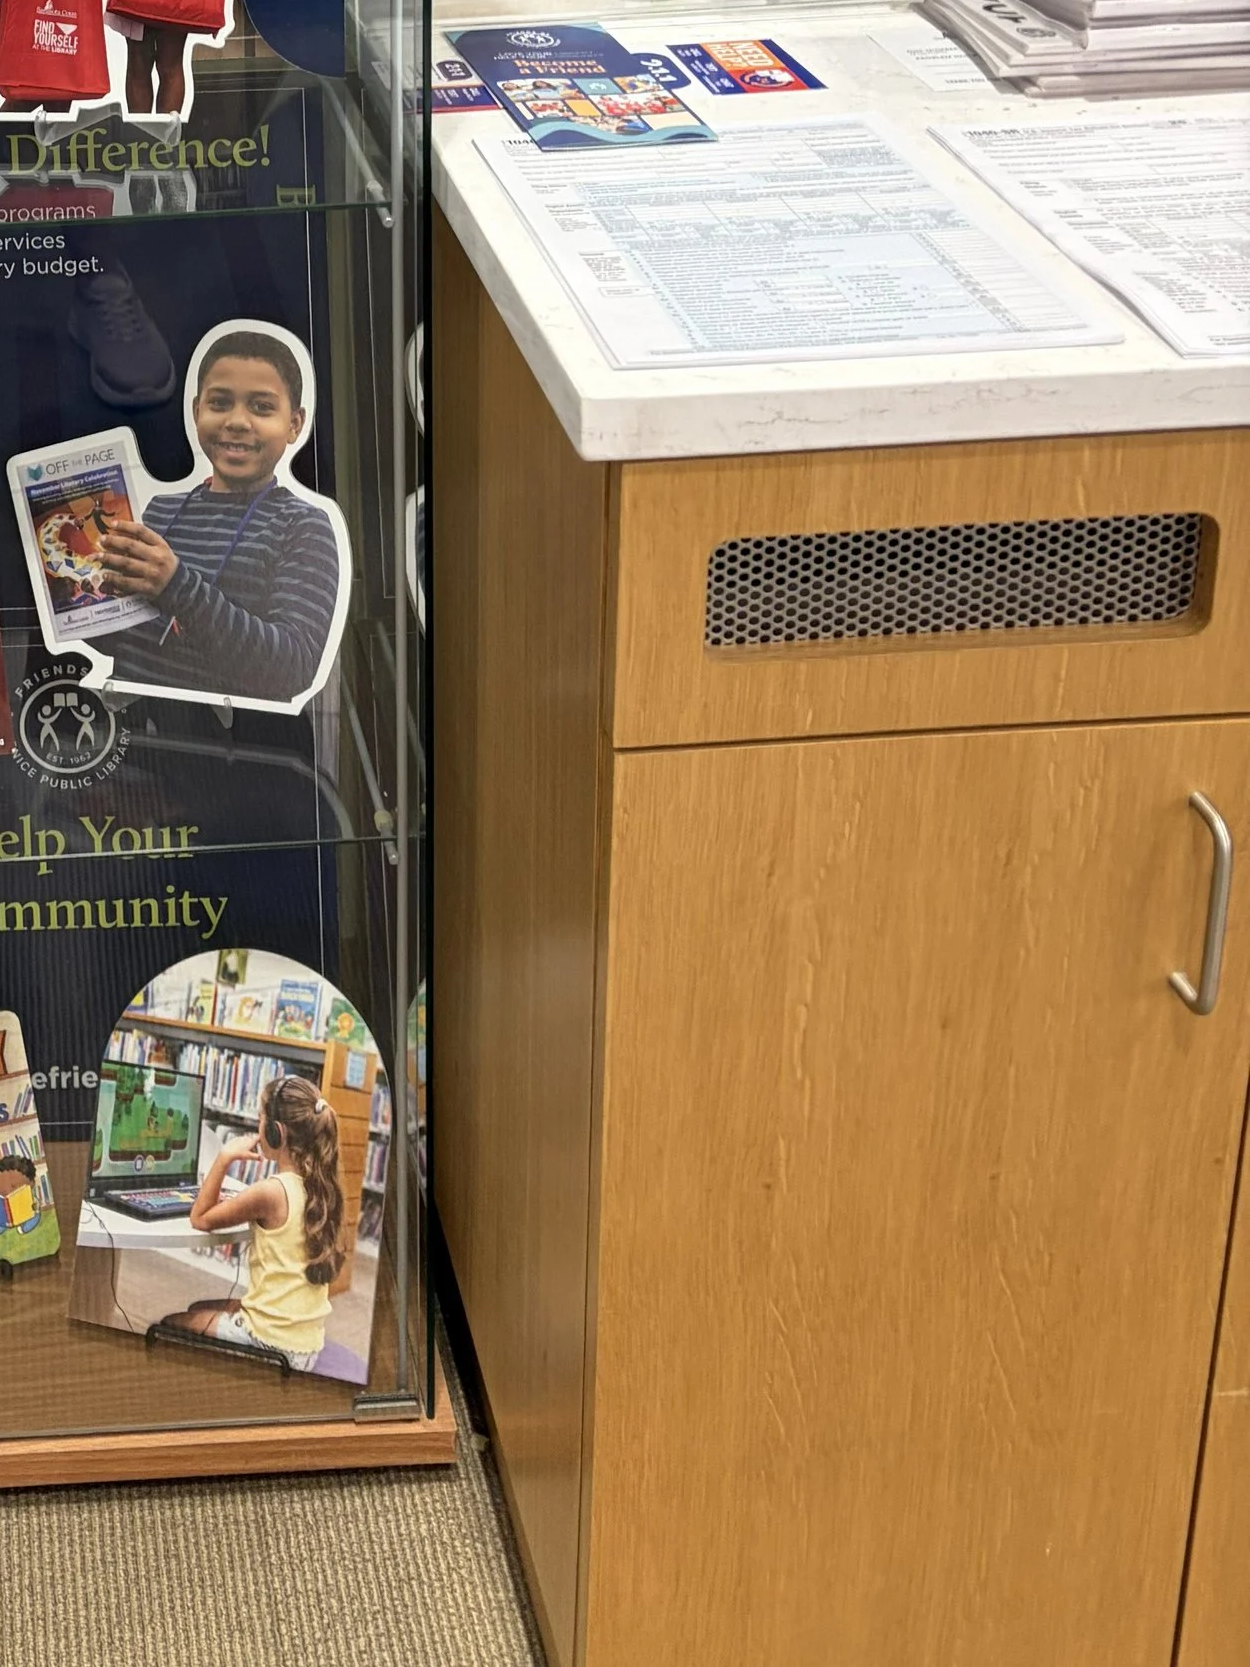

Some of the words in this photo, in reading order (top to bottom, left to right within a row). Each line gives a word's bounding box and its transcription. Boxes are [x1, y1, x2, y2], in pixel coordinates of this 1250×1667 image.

[34, 20, 55, 34] FIND
[34, 33, 78, 49] YOURSELF
[51, 46, 78, 56] LIBRARY
[514, 59, 598, 68] Become
[730, 42, 774, 67] NEED
[6, 125, 271, 176] Difference!
[22, 255, 105, 278] budget.
[45, 459, 69, 476] OFF
[84, 449, 115, 466] PAGE
[15, 664, 90, 697] FRIENDS
[12, 747, 37, 778] NICE
[40, 774, 93, 789] PUBLIC
[96, 727, 131, 780] LIBRARY
[70, 752, 91, 764] 1962
[81, 815, 199, 858] Your
